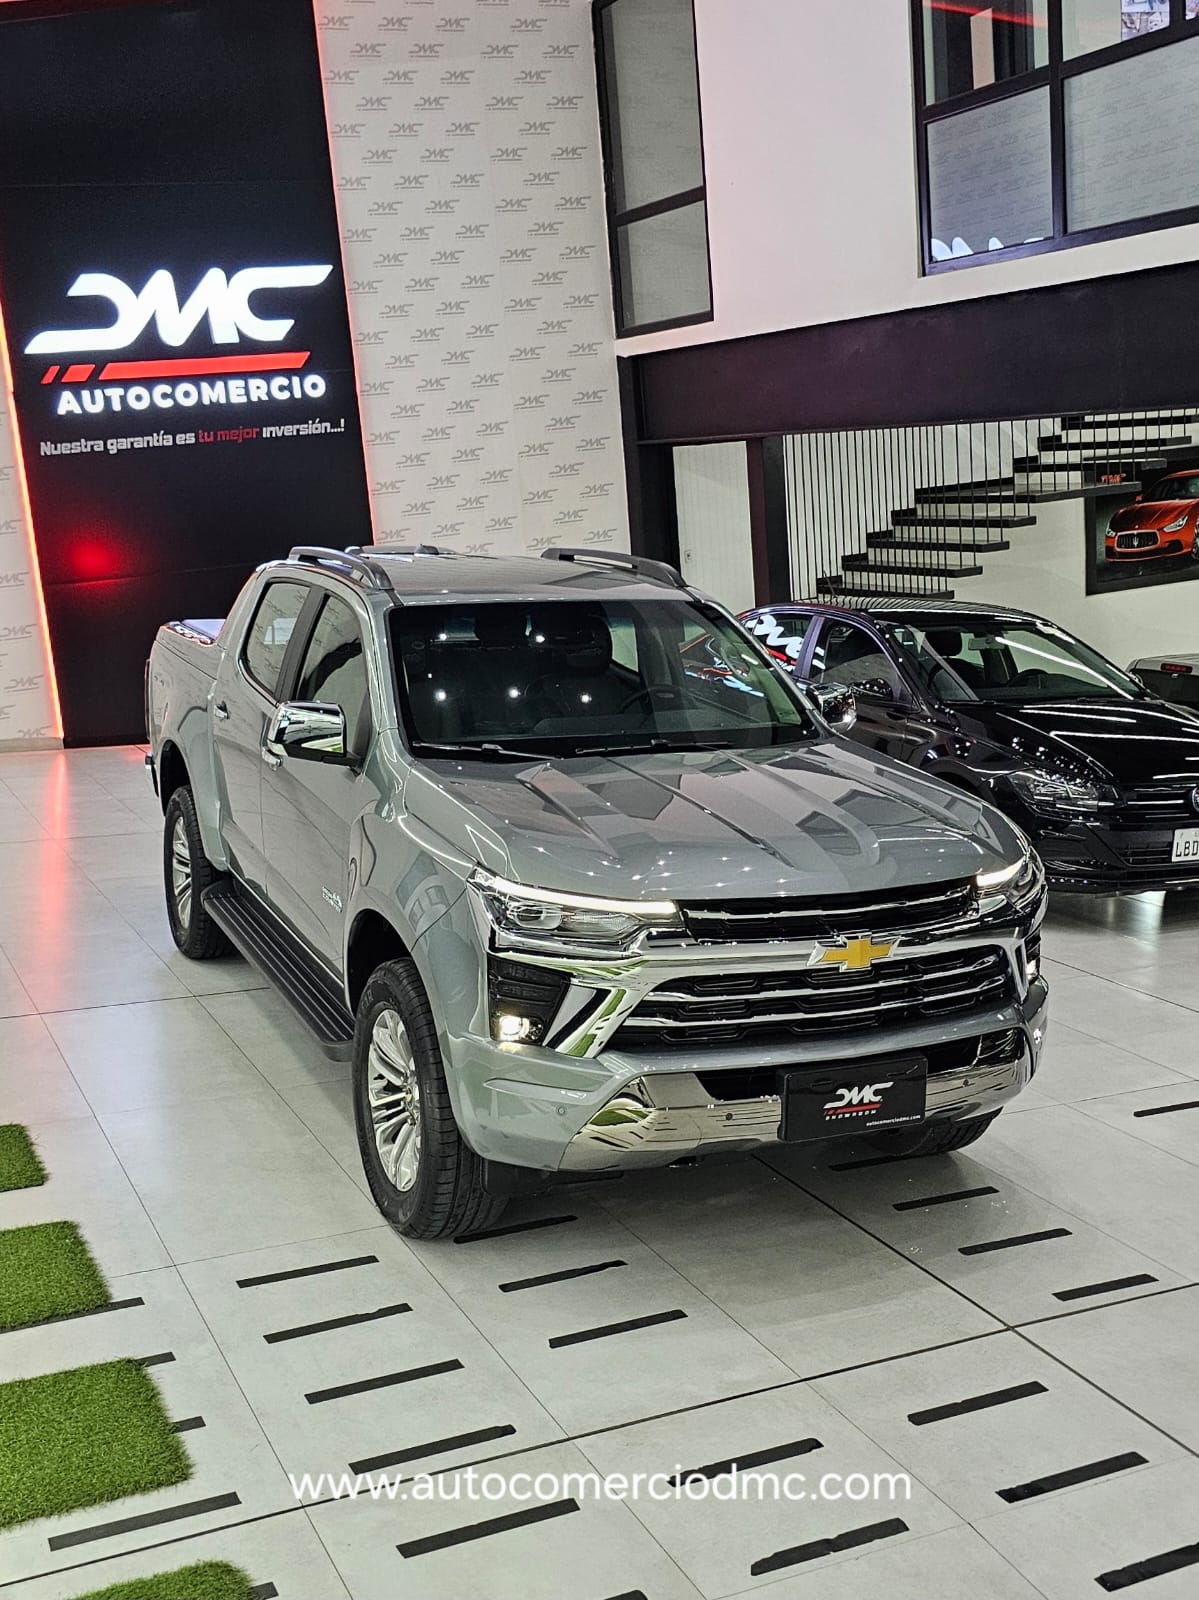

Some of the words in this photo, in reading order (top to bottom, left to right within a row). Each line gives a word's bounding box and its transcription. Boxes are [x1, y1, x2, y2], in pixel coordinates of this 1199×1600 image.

[24, 265, 334, 354] DMC
[57, 374, 327, 415] AUTOCOMERCIO
[40, 438, 104, 456] Nuestra
[107, 429, 173, 454] garantía
[176, 432, 196, 446] es
[199, 430, 215, 443] tu
[217, 426, 260, 443] mejor
[823, 1081, 894, 1109] DMC
